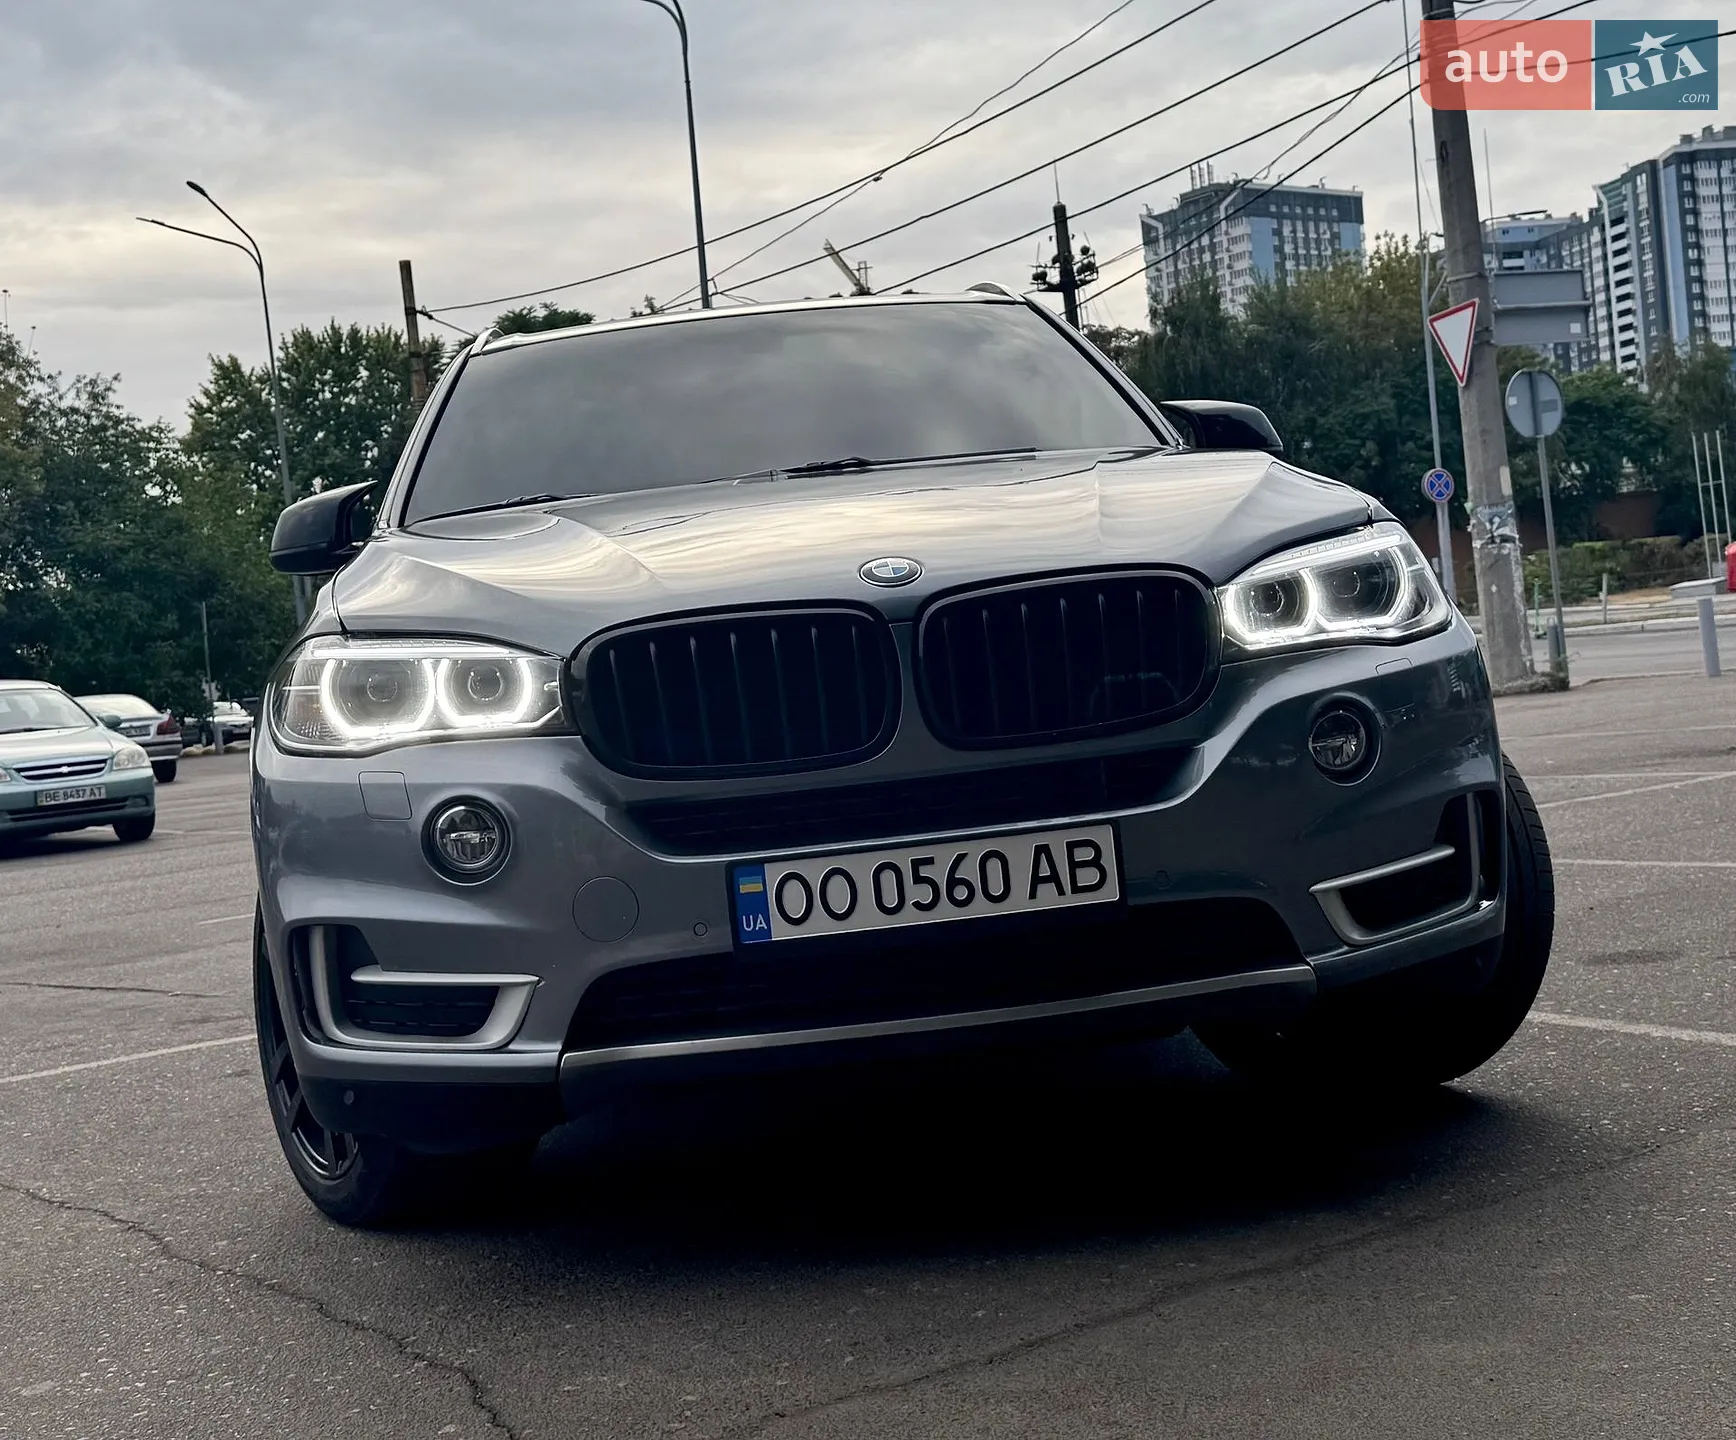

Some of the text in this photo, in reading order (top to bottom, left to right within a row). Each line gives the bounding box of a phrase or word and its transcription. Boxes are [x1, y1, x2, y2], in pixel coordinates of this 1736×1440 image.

[44, 791, 60, 803] BE
[89, 786, 103, 798] AT
[774, 838, 1108, 926] OO 0560 AB
[742, 913, 767, 932] UA
